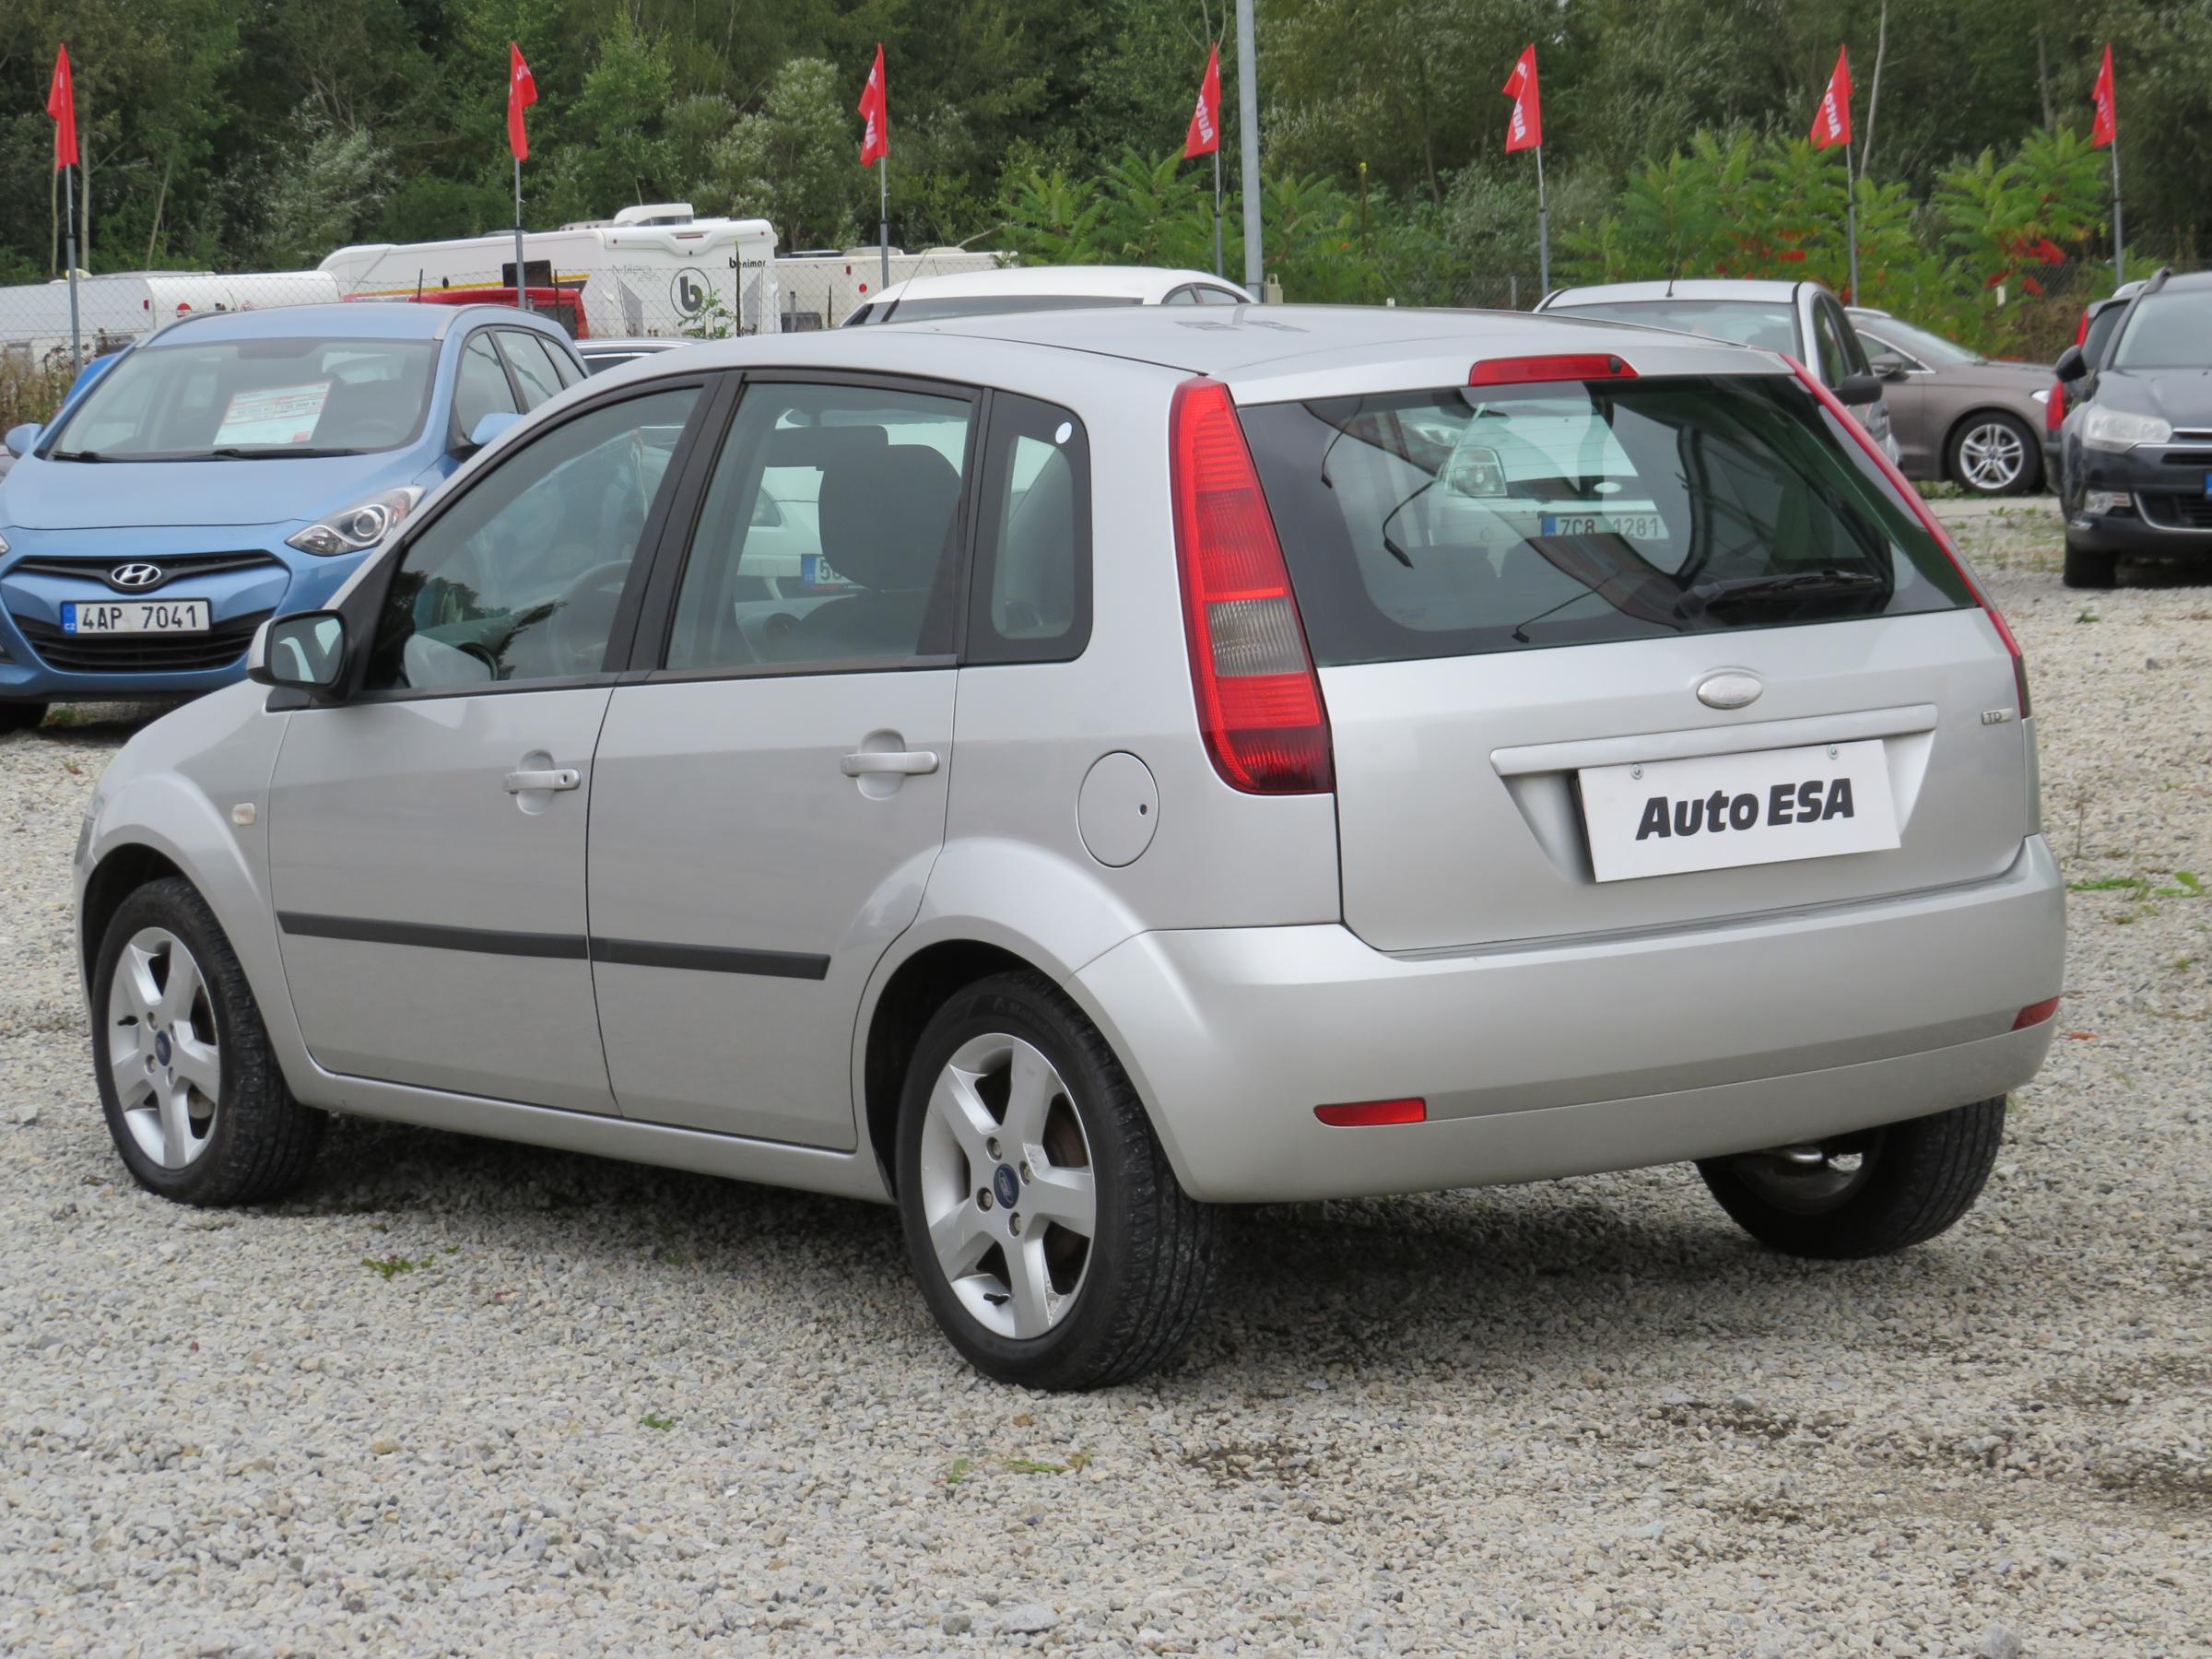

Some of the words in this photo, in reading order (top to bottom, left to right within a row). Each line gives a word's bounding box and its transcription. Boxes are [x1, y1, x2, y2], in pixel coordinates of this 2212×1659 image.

[729, 256, 766, 268] bnimar
[1560, 519, 1594, 535] 7C8
[1613, 517, 1658, 537] 1281
[82, 606, 123, 629] 4AP
[141, 605, 196, 629] 7041
[1635, 789, 1759, 841] Auto
[1767, 778, 1854, 827] ESA
